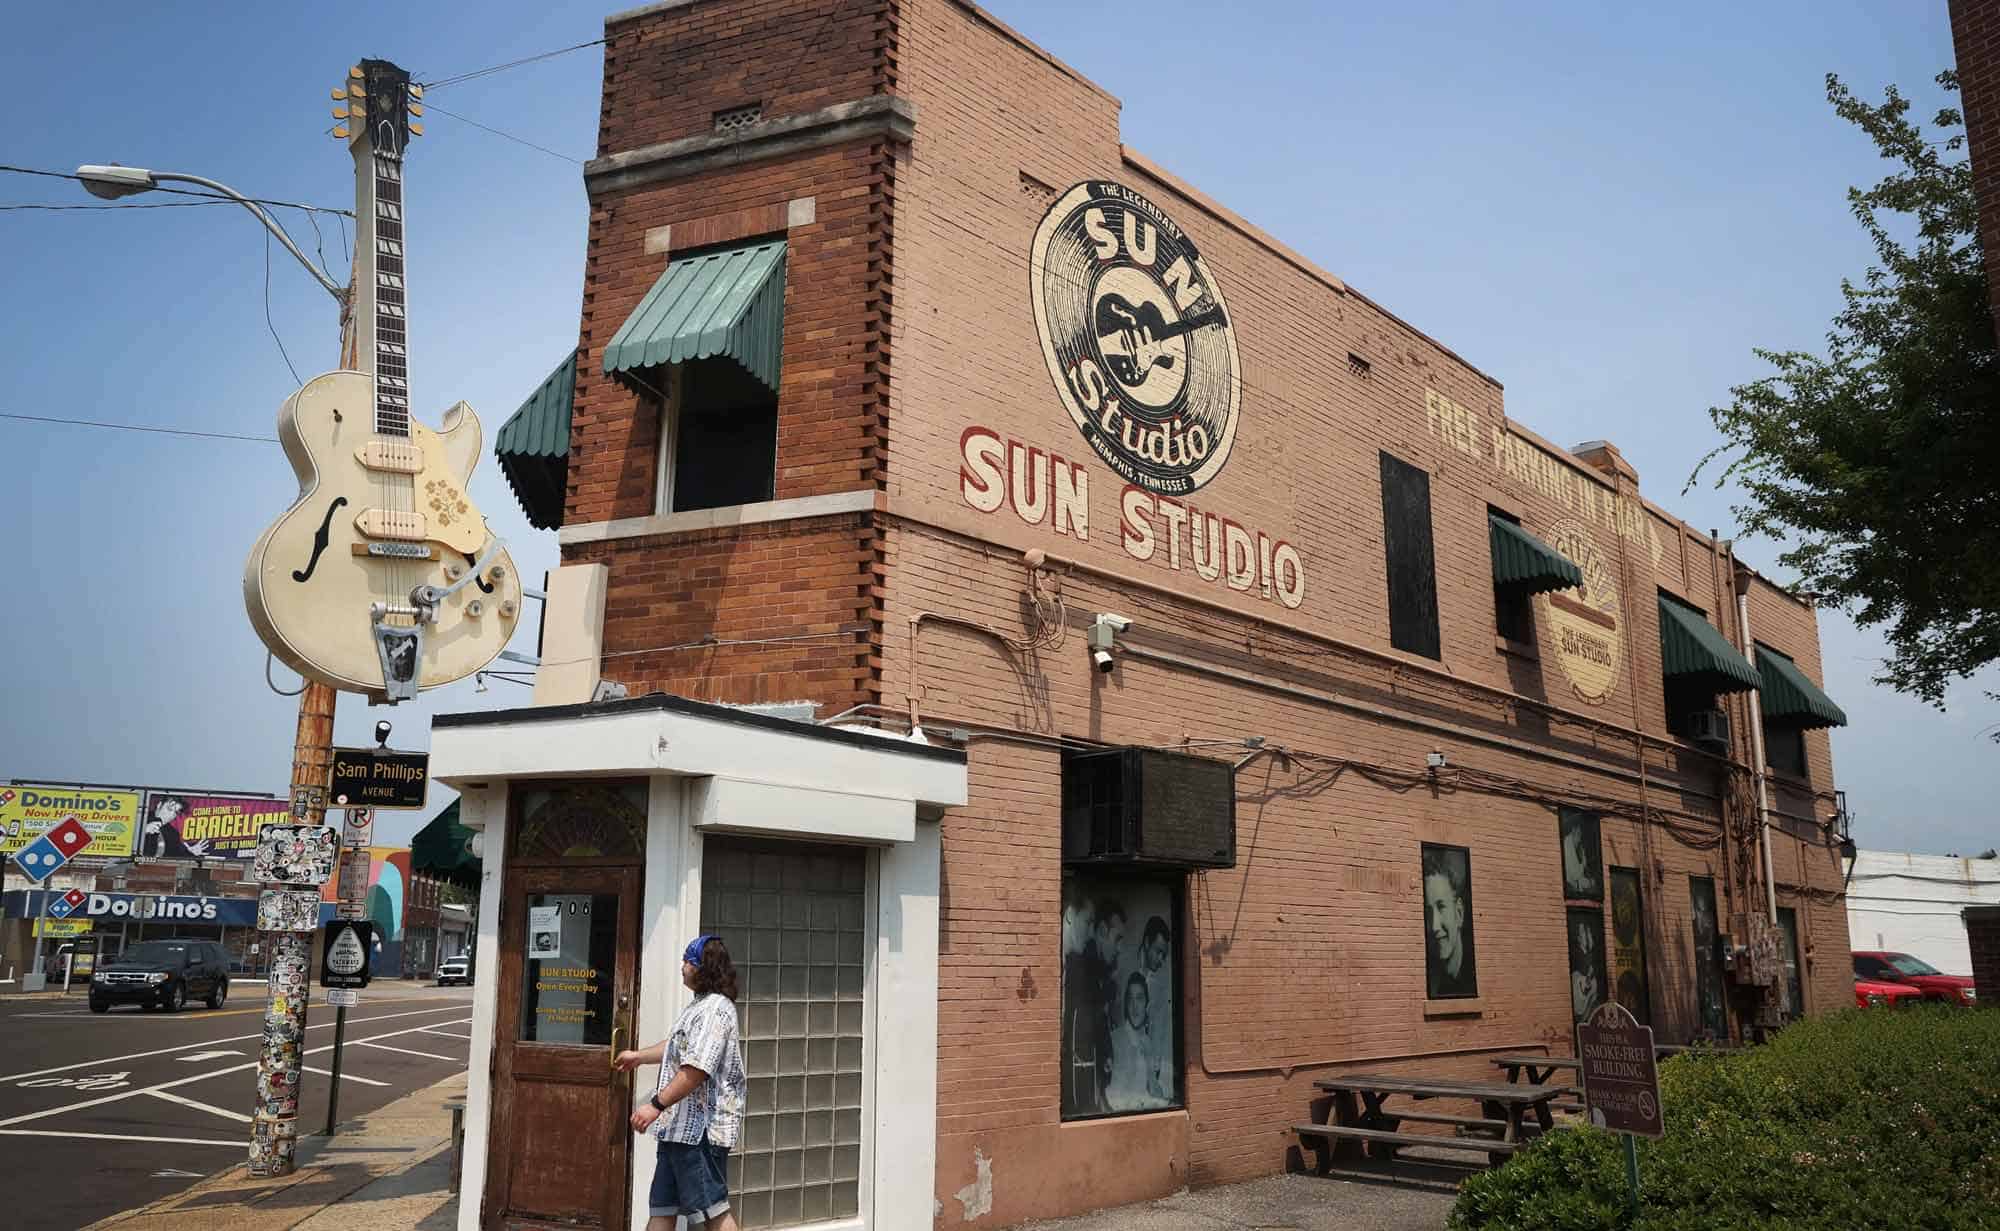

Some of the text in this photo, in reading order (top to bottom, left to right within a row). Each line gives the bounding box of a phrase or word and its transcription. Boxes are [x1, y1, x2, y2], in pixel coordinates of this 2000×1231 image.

[1099, 183, 1183, 240] THE LEGENDARY
[1083, 207, 1203, 311] SUN
[1068, 356, 1208, 466] Studio
[1425, 386, 1481, 459] FREE
[1138, 471, 1189, 491] TENNESSEE
[960, 426, 1305, 609] SUN STUDIO
[1560, 638, 1611, 667] SUN STUDIO
[336, 761, 424, 783] Sam Phillips
[21, 791, 121, 811] Domino's
[362, 786, 395, 798] AVENUE
[24, 808, 130, 821] Now Hiring Drivers
[193, 807, 211, 817] COME
[9, 839, 26, 848] TEXT
[555, 901, 590, 916] 706
[561, 968, 597, 978] STUDIO
[536, 982, 557, 992] Open
[583, 983, 599, 994] Day
[1585, 1045, 1647, 1061] SMOKE-FREE
